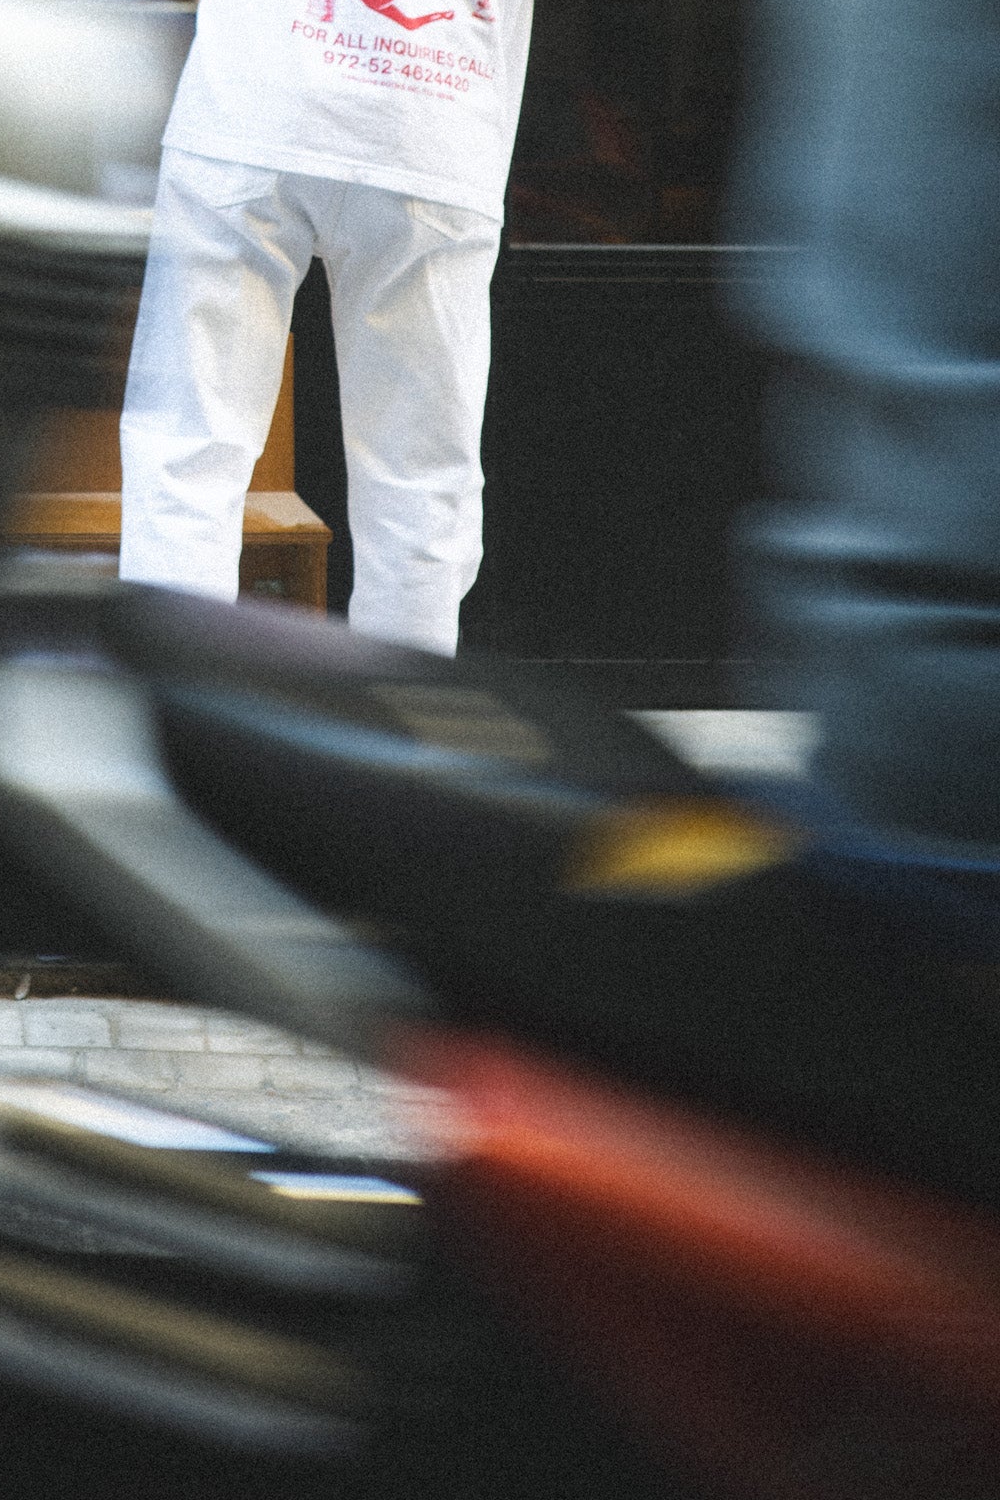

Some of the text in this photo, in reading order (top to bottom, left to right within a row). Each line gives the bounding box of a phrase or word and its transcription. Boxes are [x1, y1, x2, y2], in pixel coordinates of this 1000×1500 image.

[290, 19, 328, 43] FOR
[332, 32, 368, 50] ALL
[373, 36, 455, 68] INQUIRIES
[323, 50, 471, 93] 972-52-4624420
